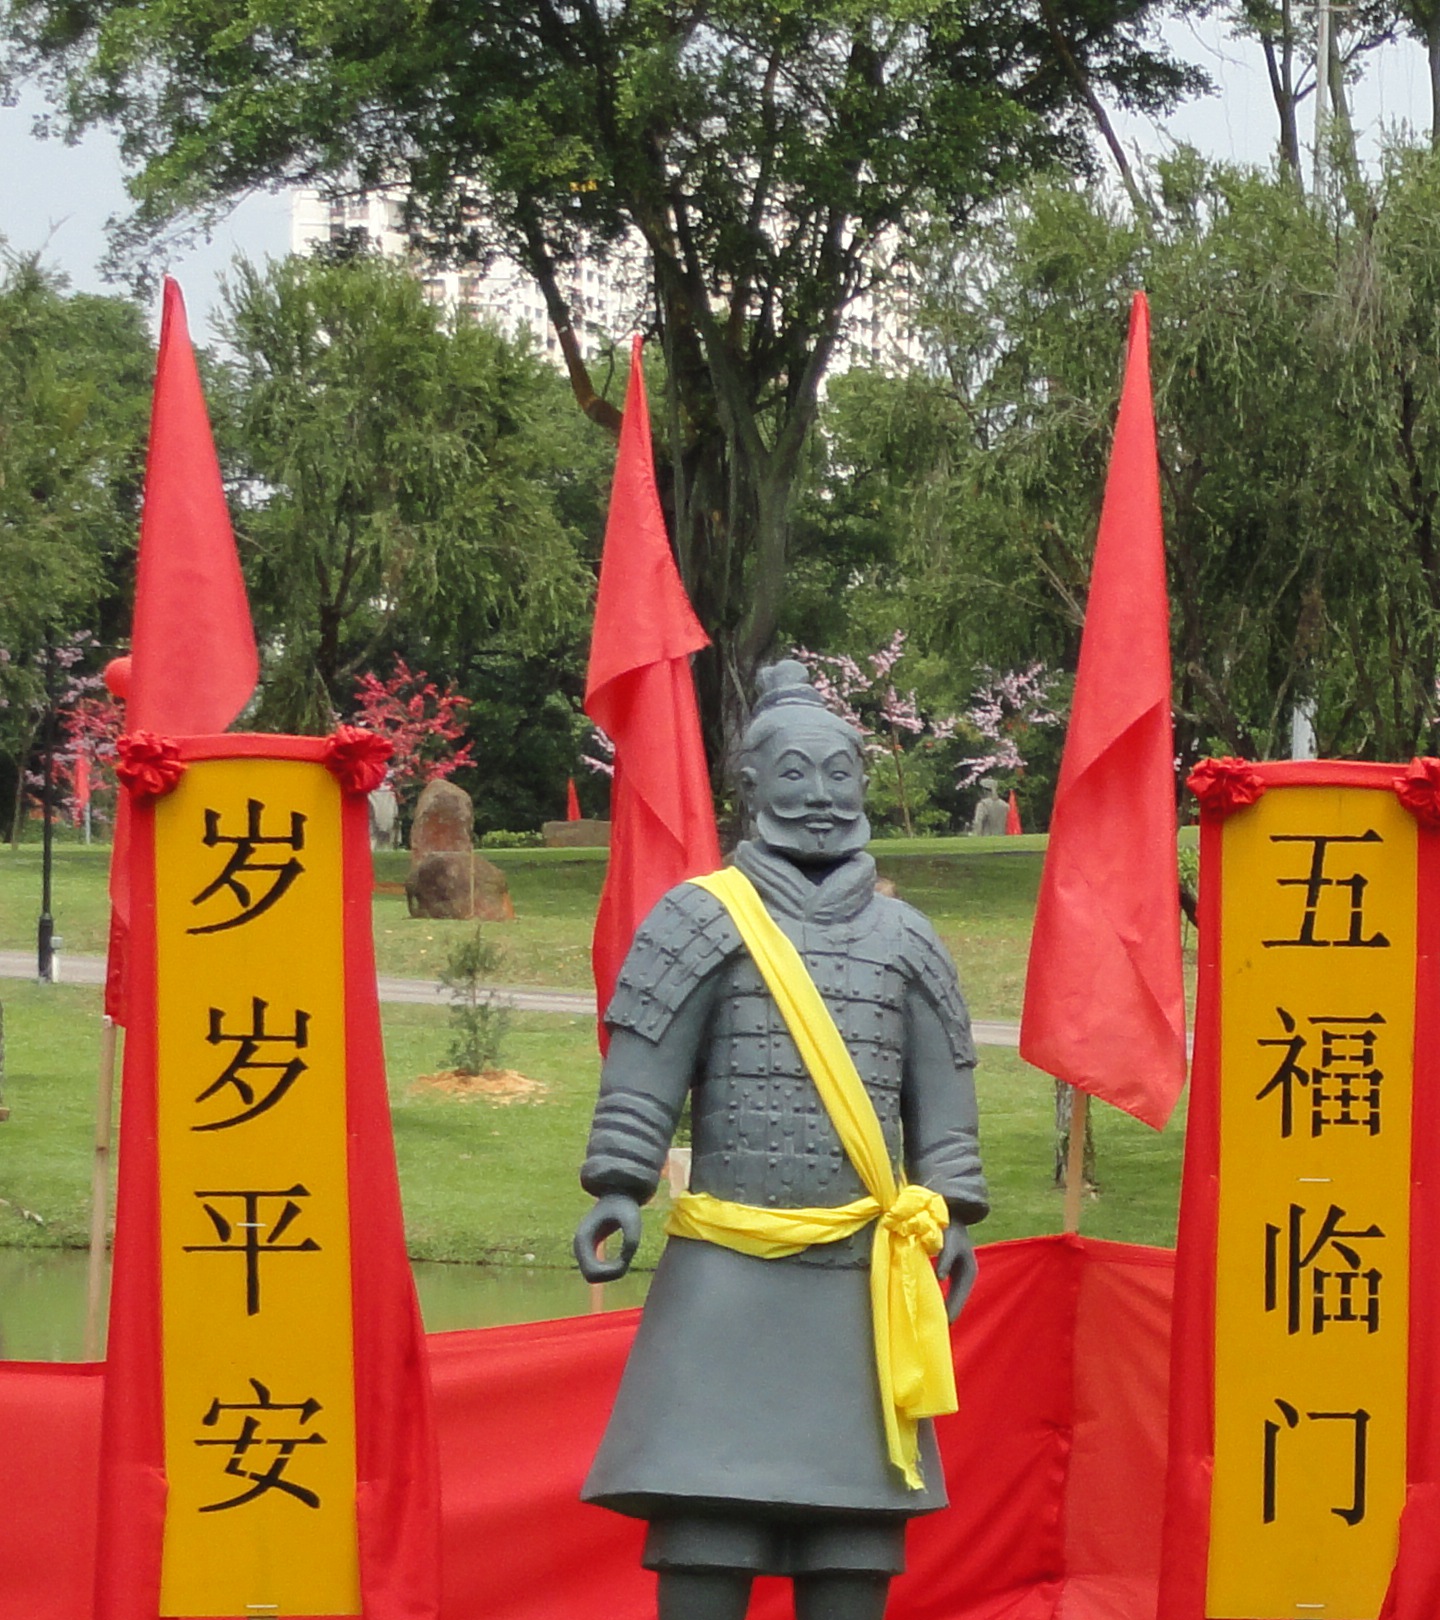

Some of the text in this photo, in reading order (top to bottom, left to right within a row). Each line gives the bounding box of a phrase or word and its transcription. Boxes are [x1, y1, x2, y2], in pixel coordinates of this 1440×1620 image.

[183, 797, 328, 1513] 岁岁平安
[1255, 828, 1391, 1527] 五福临门
